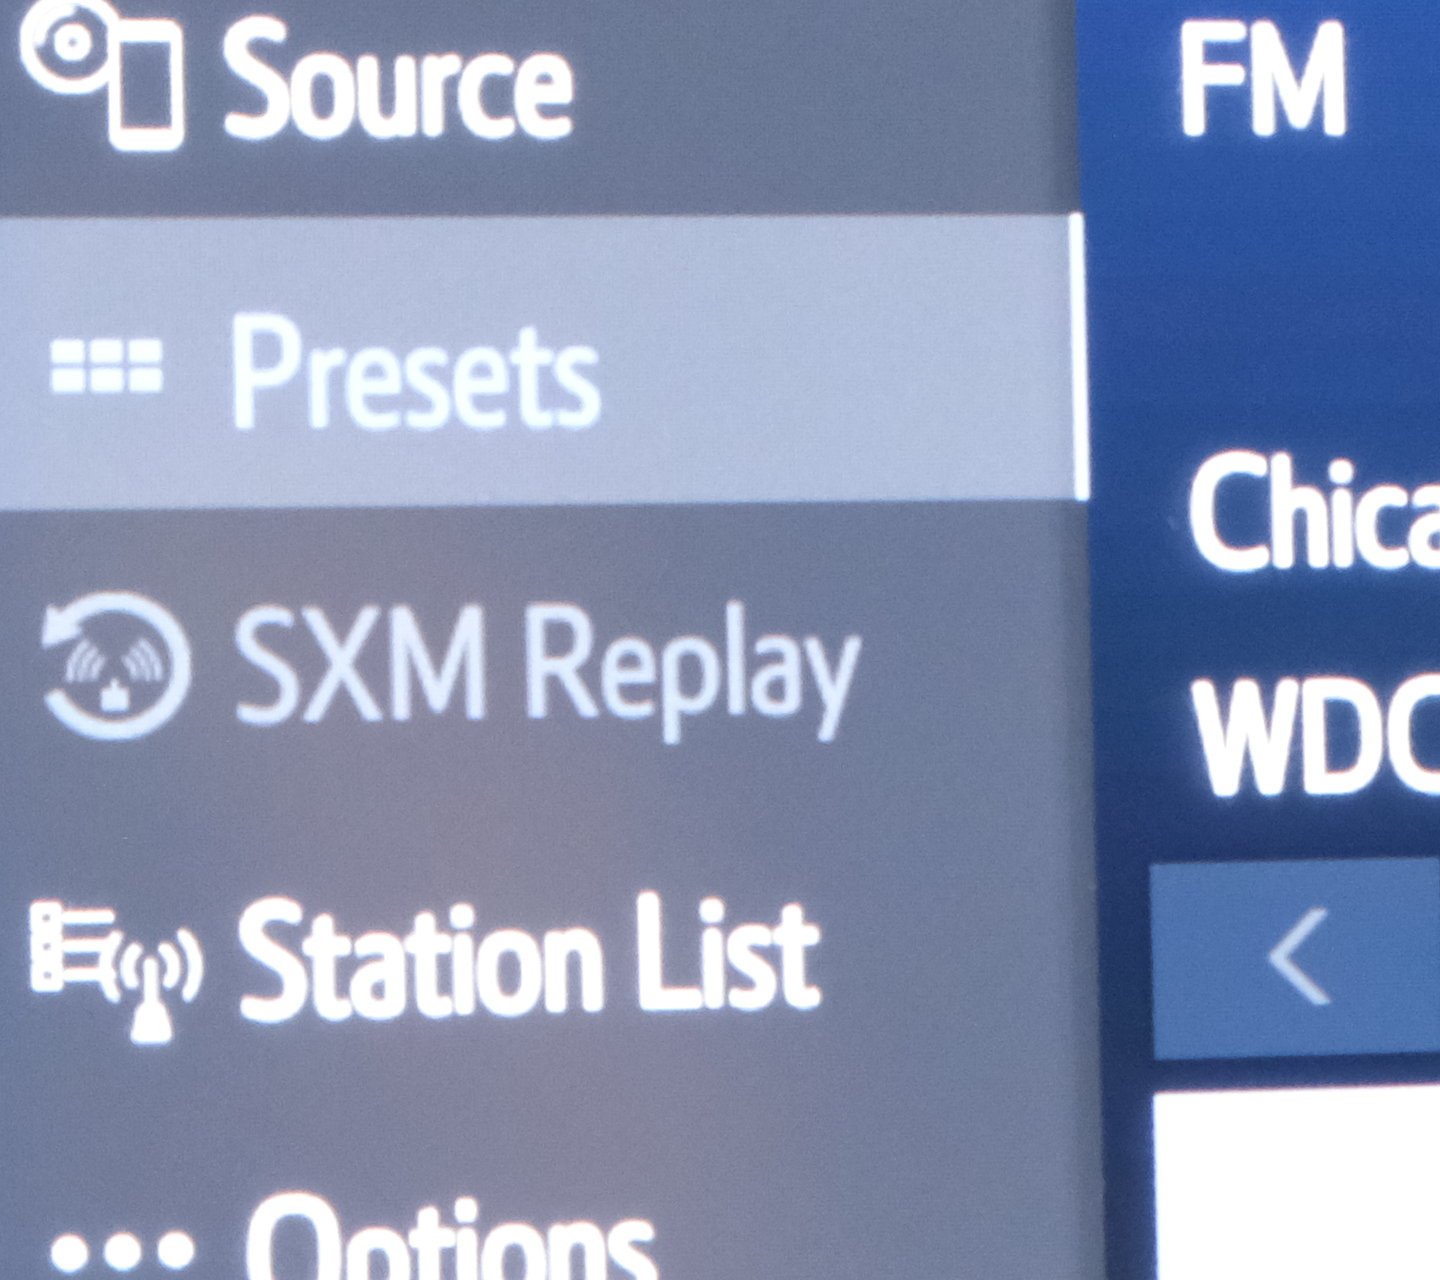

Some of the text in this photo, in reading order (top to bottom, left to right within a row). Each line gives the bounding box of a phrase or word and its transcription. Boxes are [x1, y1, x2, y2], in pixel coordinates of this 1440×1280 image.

[221, 14, 575, 142] Source
[1179, 18, 1348, 138] FM
[231, 310, 603, 432] Presets
[231, 598, 863, 746] SXM Replay
[237, 890, 823, 1024] Station List
